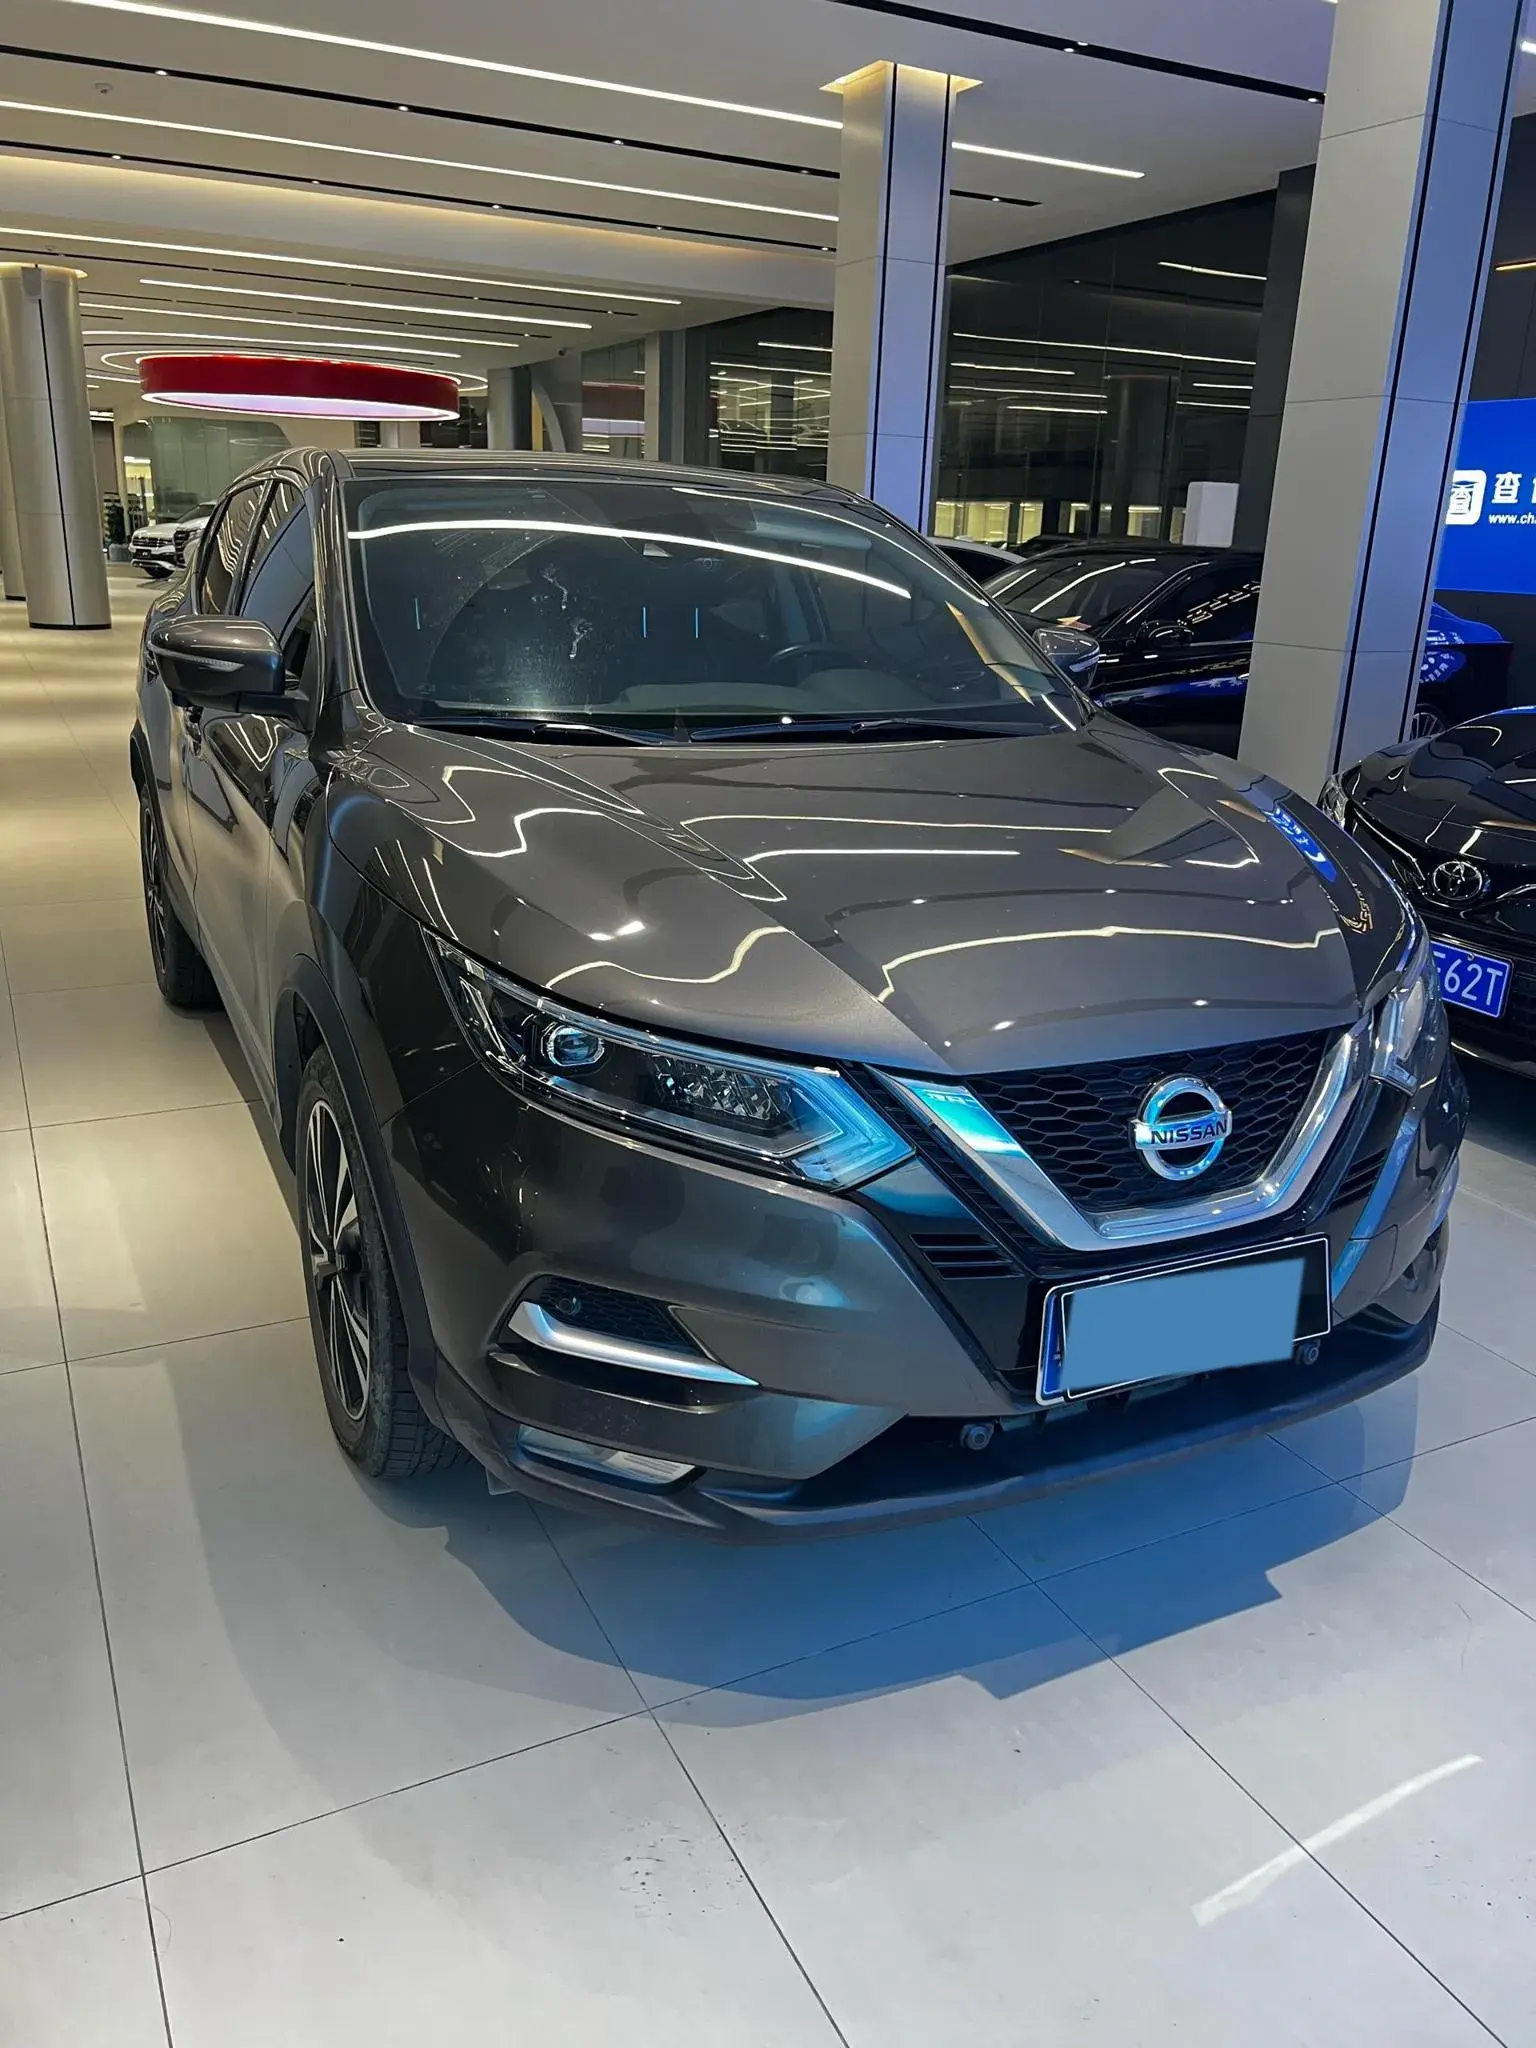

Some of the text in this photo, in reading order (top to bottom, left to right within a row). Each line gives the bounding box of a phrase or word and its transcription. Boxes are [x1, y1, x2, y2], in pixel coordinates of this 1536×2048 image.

[1491, 471, 1536, 504] 查
[1488, 511, 1536, 525] www.ch
[1150, 1120, 1228, 1145] NISSAN
